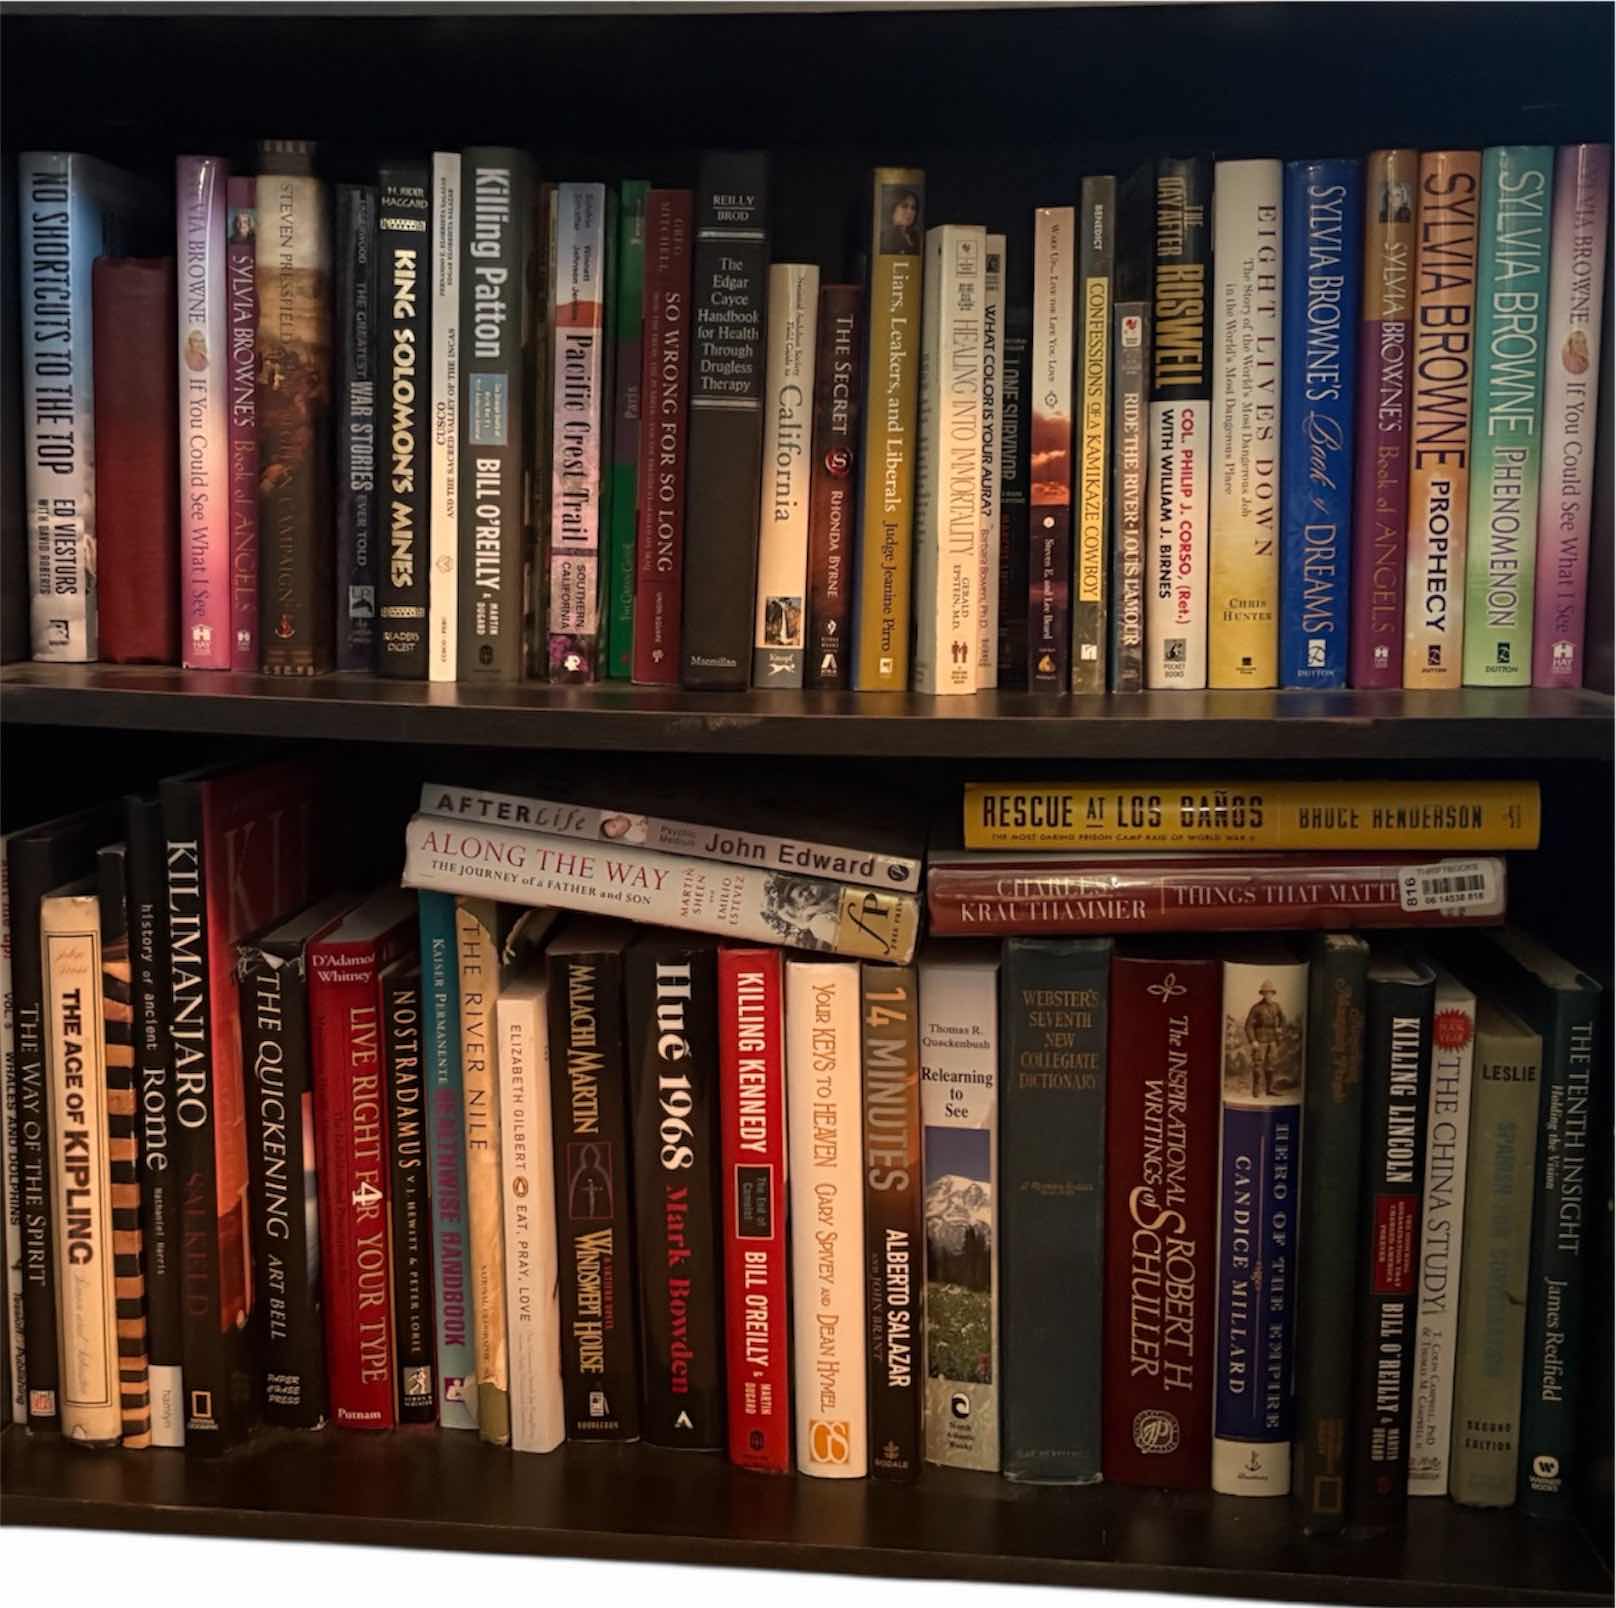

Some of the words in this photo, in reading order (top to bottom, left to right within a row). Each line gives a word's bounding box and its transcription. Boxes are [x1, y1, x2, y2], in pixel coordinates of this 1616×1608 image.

[32, 172, 69, 201] NO
[470, 168, 510, 258] Killing
[658, 202, 670, 272] MITCHELL
[1092, 204, 1103, 251] BENEDICT
[1420, 172, 1476, 294] SYLVIA
[1493, 170, 1544, 280] SYLVIA
[32, 211, 70, 342] SHORTCUTS
[393, 249, 417, 319] KING
[1243, 258, 1255, 282] The
[1257, 205, 1277, 318] EIGHT
[475, 266, 508, 358] Patton
[663, 292, 681, 321] SO
[1240, 284, 1253, 315] Story
[835, 314, 854, 355] THE
[983, 304, 996, 352] WHAT
[1155, 264, 1204, 389] ROSWELL
[1243, 319, 1254, 330] of
[1243, 334, 1253, 352] the
[36, 349, 71, 376] TO
[564, 334, 593, 411] Pacific
[661, 330, 681, 415] WRONG
[952, 319, 979, 394] HEALING
[1242, 355, 1253, 398] World's
[1488, 291, 1538, 436] BROWNE
[36, 384, 73, 425] THE
[831, 361, 852, 435] SECRET
[982, 354, 996, 408] COLOR
[1256, 336, 1275, 441] LIVES
[1416, 305, 1470, 469] BROWNE
[391, 329, 415, 495] SOLOMON'S
[437, 402, 446, 445] CUSCO
[951, 400, 978, 441] INTO
[982, 408, 994, 420] IS
[1160, 408, 1174, 450] WITH
[1241, 402, 1253, 431] Most
[37, 431, 74, 474] TOP
[563, 421, 591, 477] Crest
[660, 422, 677, 466] FOR
[774, 384, 803, 523] California
[981, 422, 994, 468] YOUR
[1239, 433, 1252, 495] Dangerous
[38, 499, 49, 521] WITH
[55, 499, 75, 516] ED
[659, 473, 675, 501] SO
[949, 448, 977, 557] IMMORTALITY
[980, 469, 993, 517] AURA?
[1160, 455, 1173, 522] WILLIAM
[1240, 497, 1250, 518] Job
[1255, 459, 1274, 556] DOWN
[38, 525, 50, 550] DAVID
[561, 488, 589, 541] Trail
[828, 490, 844, 550] RHONDA
[1159, 526, 1173, 540] J.
[1488, 448, 1528, 628] PHENOMENON
[56, 524, 77, 595] VIESTURS
[390, 501, 414, 588] MINES
[657, 510, 675, 573] LONG
[1426, 481, 1450, 631] PROPHECY
[39, 555, 50, 595] ROBERTS
[561, 561, 572, 629] CALIFORNIA
[826, 555, 841, 598] BYRNE
[951, 565, 961, 607] EPSTEIN,
[1159, 544, 1171, 599] BIRNES
[477, 602, 486, 635] DUGARD
[490, 602, 499, 635] MARTIN
[575, 564, 586, 628] SOUTHERN
[961, 577, 970, 618] GERALD
[1223, 612, 1272, 621] HUNTER
[1229, 599, 1267, 608] CHRIS
[951, 610, 961, 632] M.D.
[690, 655, 737, 667] Macmillan
[983, 796, 1073, 828] RESCUE
[1086, 797, 1105, 820] AT
[1117, 796, 1162, 828] LOS
[1180, 790, 1264, 828] BAÑOS
[1298, 805, 1358, 830] BRUCE
[1372, 805, 1482, 830] HENDERSON
[421, 830, 527, 868] ALONG
[537, 849, 596, 880] THE
[606, 860, 670, 892] WAY
[705, 834, 766, 860] John
[778, 844, 875, 877] Edward
[693, 874, 706, 913] SHEEN
[960, 899, 1147, 922] KRAUTHAMMER
[1404, 877, 1418, 906] 816
[462, 924, 481, 975] THE
[165, 839, 208, 1129] KILIMANJARO
[255, 971, 280, 1031] THE
[567, 964, 598, 1047] MALACHI
[812, 984, 836, 1023] YOUR
[865, 987, 907, 1026] 14
[1023, 988, 1100, 1008] WEBSTER'S
[19, 1001, 39, 1053] THE
[62, 988, 82, 1035] THE
[464, 992, 485, 1073] RIVER
[737, 972, 767, 1052] KILLING
[928, 1023, 969, 1034] Thomas
[971, 1025, 984, 1036] R.
[1029, 1009, 1097, 1029] SEVENTH
[1168, 1015, 1189, 1047] The
[509, 1024, 524, 1103] ELIZABETH
[812, 1028, 836, 1071] KEYS
[922, 1037, 991, 1049] Quackenbush
[1019, 1051, 1097, 1070] COLLEGIATE
[1043, 1031, 1078, 1049] NEW
[1389, 1016, 1421, 1096] KILLING
[1568, 1022, 1593, 1064] THE
[20, 1062, 41, 1114] WAY
[63, 1041, 83, 1088] AGE
[392, 991, 422, 1169] NOSTRADAMUS
[816, 1076, 832, 1098] TO
[922, 1067, 993, 1088] Relearning
[1018, 1072, 1096, 1089] DICTIONARY
[1434, 1056, 1461, 1114] THE
[1481, 1064, 1536, 1082] LESLIE
[66, 1093, 85, 1125] OF
[566, 1048, 606, 1135] MARTIN
[738, 1059, 767, 1153] KENNEDY
[867, 1039, 909, 1192] MINUTES
[1564, 1068, 1591, 1148] TENTH
[24, 1121, 41, 1151] OF
[253, 1040, 290, 1240] QUICKENING
[469, 1089, 488, 1151] NILE
[513, 1109, 527, 1170] GILBERT
[813, 1102, 837, 1168] HEAVEN
[1165, 1050, 1189, 1207] INSPIRATIONAL
[1385, 1105, 1417, 1184] LINCOLN
[1428, 1122, 1457, 1211] CHINA
[25, 1159, 43, 1206] THE
[65, 1130, 93, 1265] KIPLING
[1557, 1156, 1583, 1256] INSIGHT
[514, 1204, 528, 1235] EAT,
[1232, 1155, 1252, 1273] CANDICE
[26, 1214, 47, 1287] SPIRIT
[267, 1254, 285, 1293] ART
[517, 1240, 529, 1281] PRAY,
[574, 1228, 613, 1317] WINDSWEPT
[886, 1229, 910, 1306] ALBERTO
[1422, 1218, 1452, 1310] STUDY
[268, 1298, 287, 1340] BELL
[519, 1286, 531, 1321] LOVE
[1163, 1236, 1196, 1357] ROBERT
[1544, 1276, 1568, 1327] James
[573, 1320, 604, 1374] HOUSE
[888, 1310, 912, 1387] SALAZAR
[1228, 1279, 1248, 1394] MILLARD
[1163, 1360, 1194, 1391] H.
[1541, 1331, 1565, 1401] Redfield
[337, 1408, 382, 1420] Putnam
[744, 1382, 756, 1414] DUGARD
[760, 1383, 772, 1415] MARTIN
[1466, 1438, 1512, 1451] EDITION
[1467, 1421, 1512, 1432] SECOND
